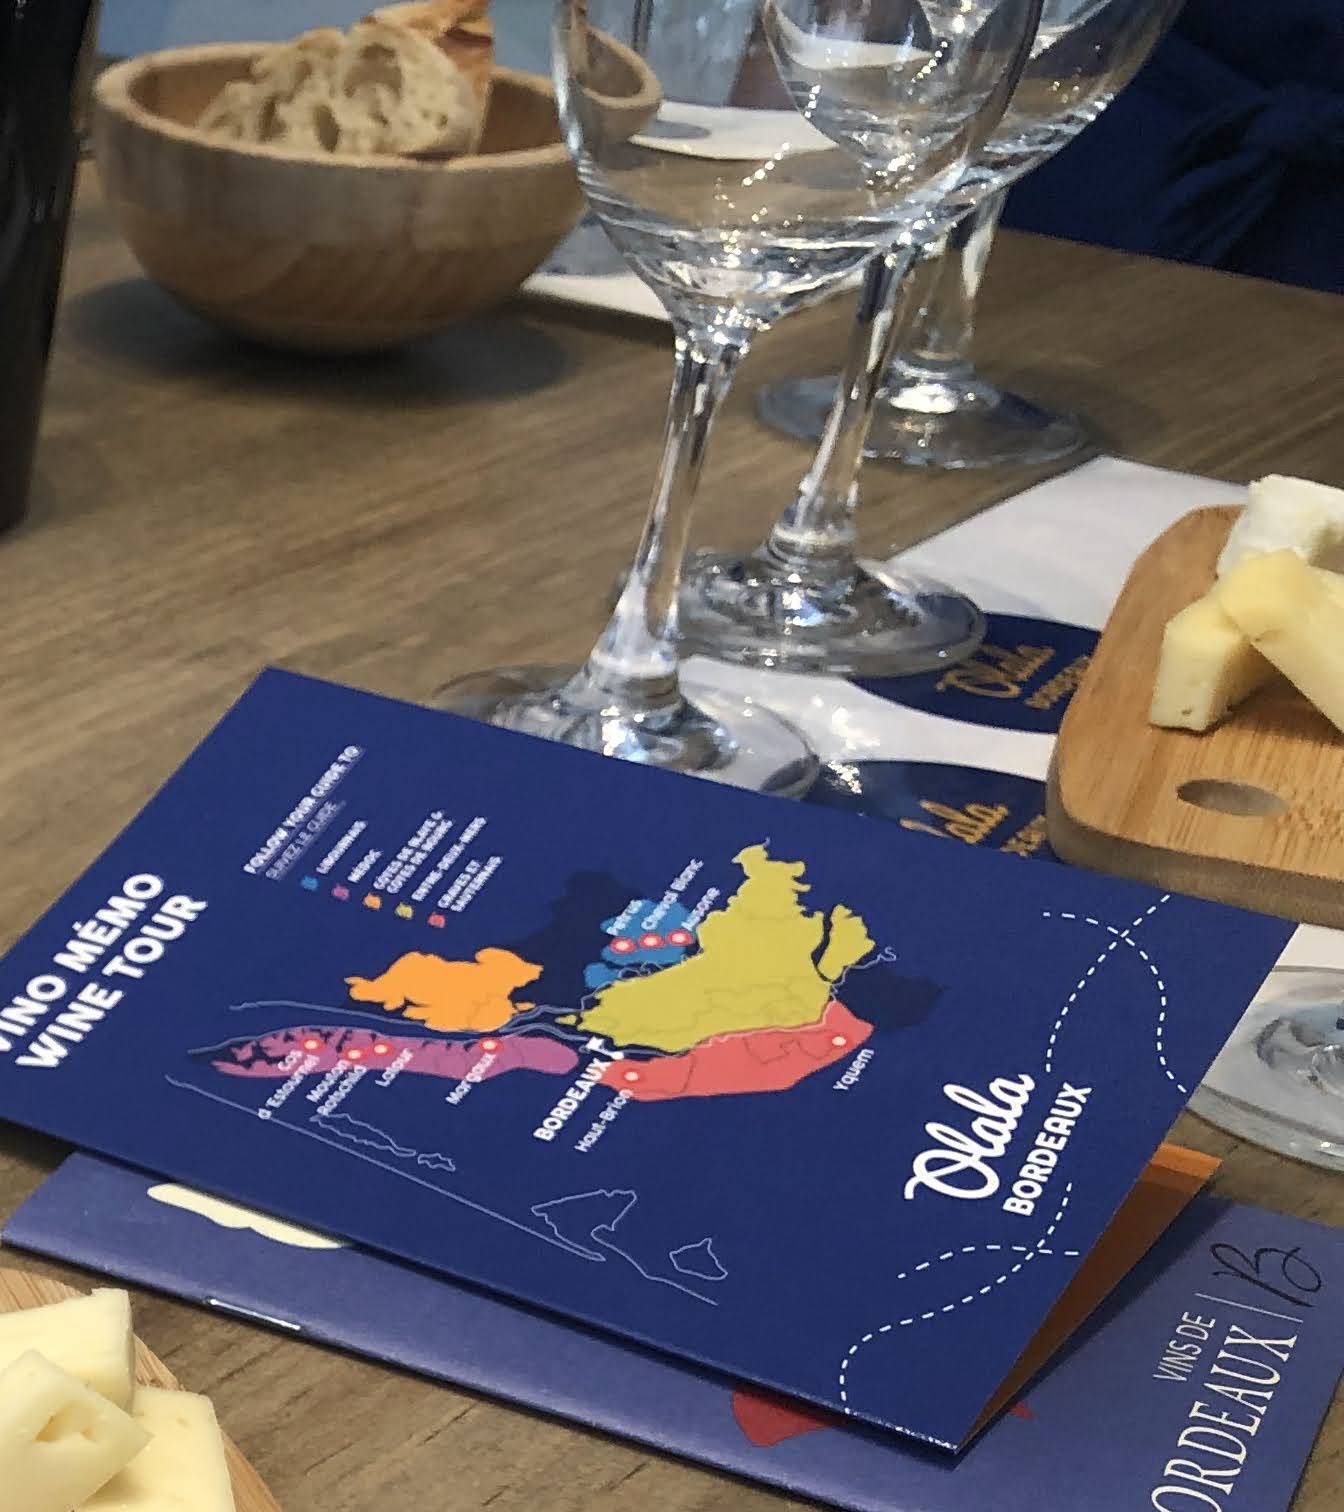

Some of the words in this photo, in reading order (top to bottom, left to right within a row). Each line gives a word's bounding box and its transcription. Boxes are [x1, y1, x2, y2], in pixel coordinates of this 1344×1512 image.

[338, 745, 360, 763] TO
[53, 873, 164, 974] MÉMO
[15, 981, 125, 1068] WINE
[101, 894, 208, 979] TOUR
[533, 1057, 612, 1141] BORDEAUX
[833, 1047, 875, 1091] Yquem
[904, 1073, 1036, 1200] Olala
[1002, 1082, 1093, 1216] BORDEAUX
[1153, 1339, 1202, 1382] VINS
[1181, 1311, 1217, 1340] DE
